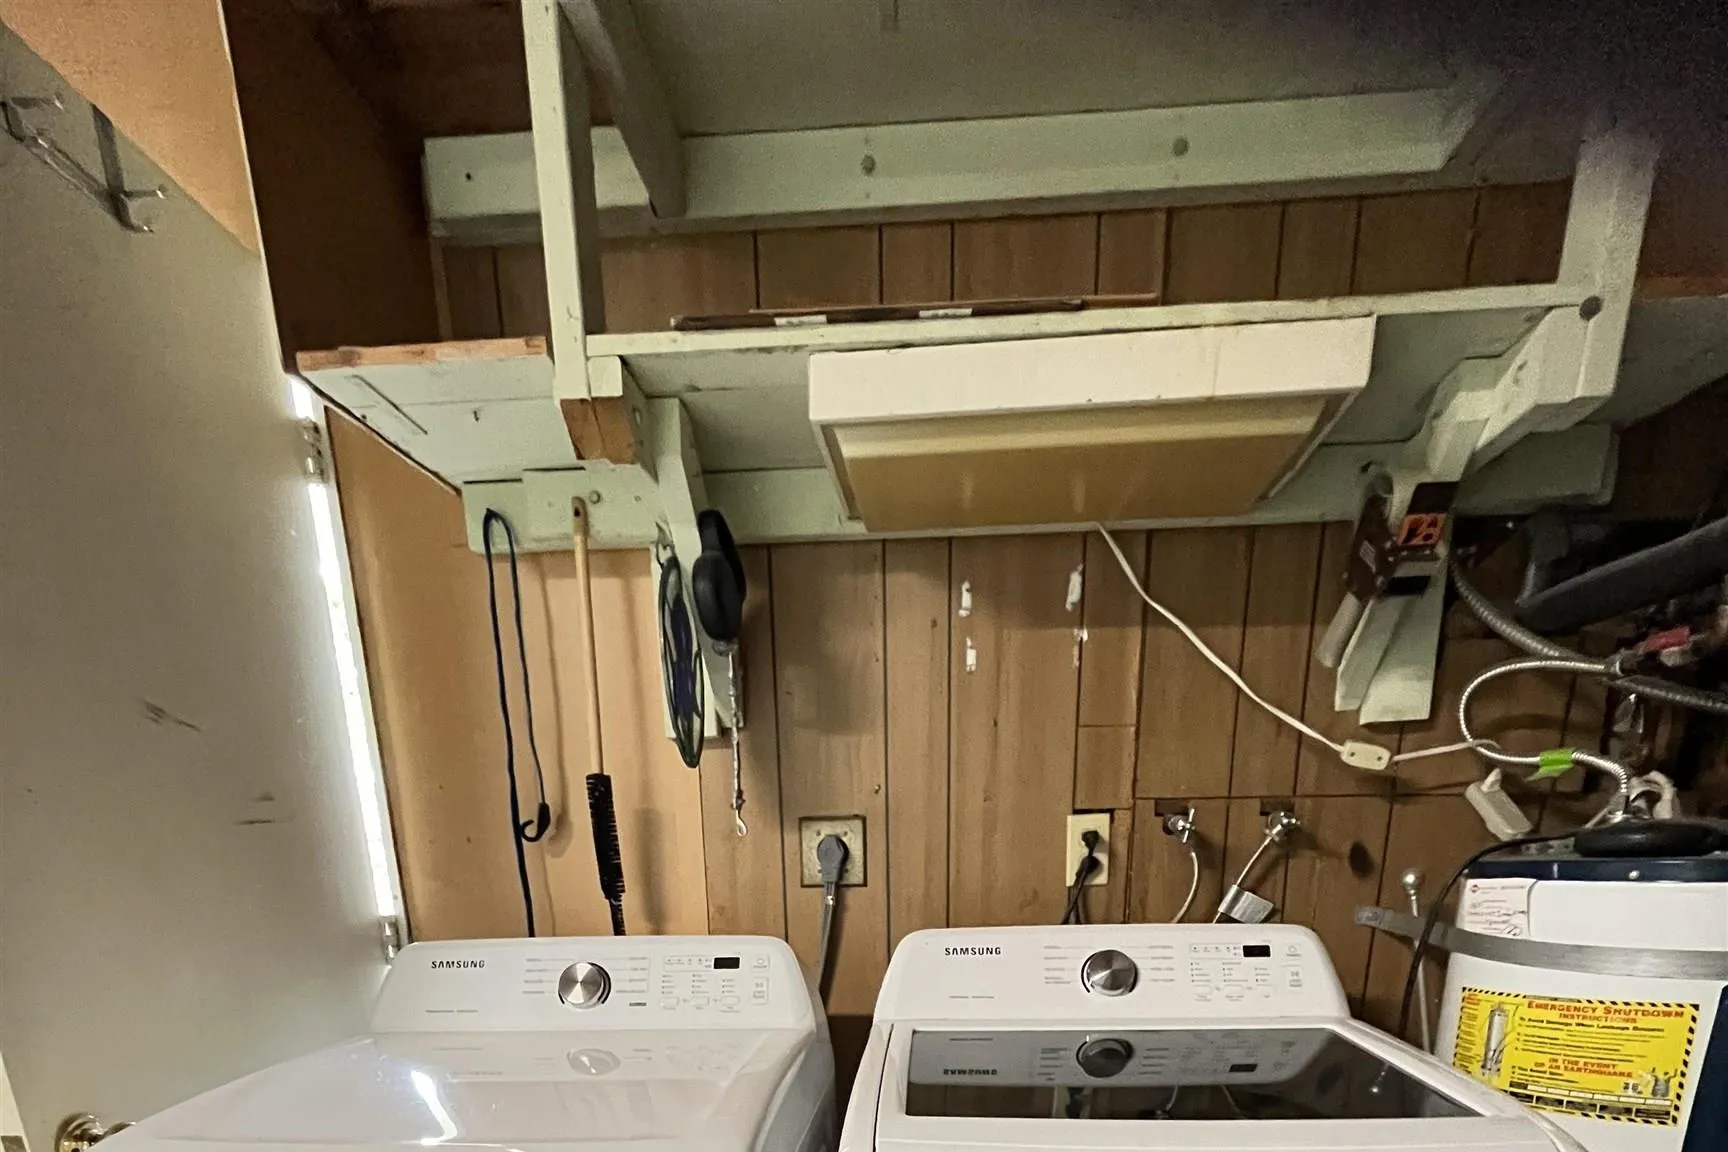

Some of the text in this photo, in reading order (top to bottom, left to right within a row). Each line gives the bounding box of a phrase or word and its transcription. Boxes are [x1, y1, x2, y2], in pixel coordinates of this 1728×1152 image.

[944, 946, 1001, 956] SAMSUNG
[431, 960, 485, 969] SAMSUNG
[1527, 1001, 1684, 1018] EMERGENCY SHUTDOWN
[1559, 1013, 1637, 1024] INSTRUCTIONS
[1583, 1061, 1619, 1070] EVENT
